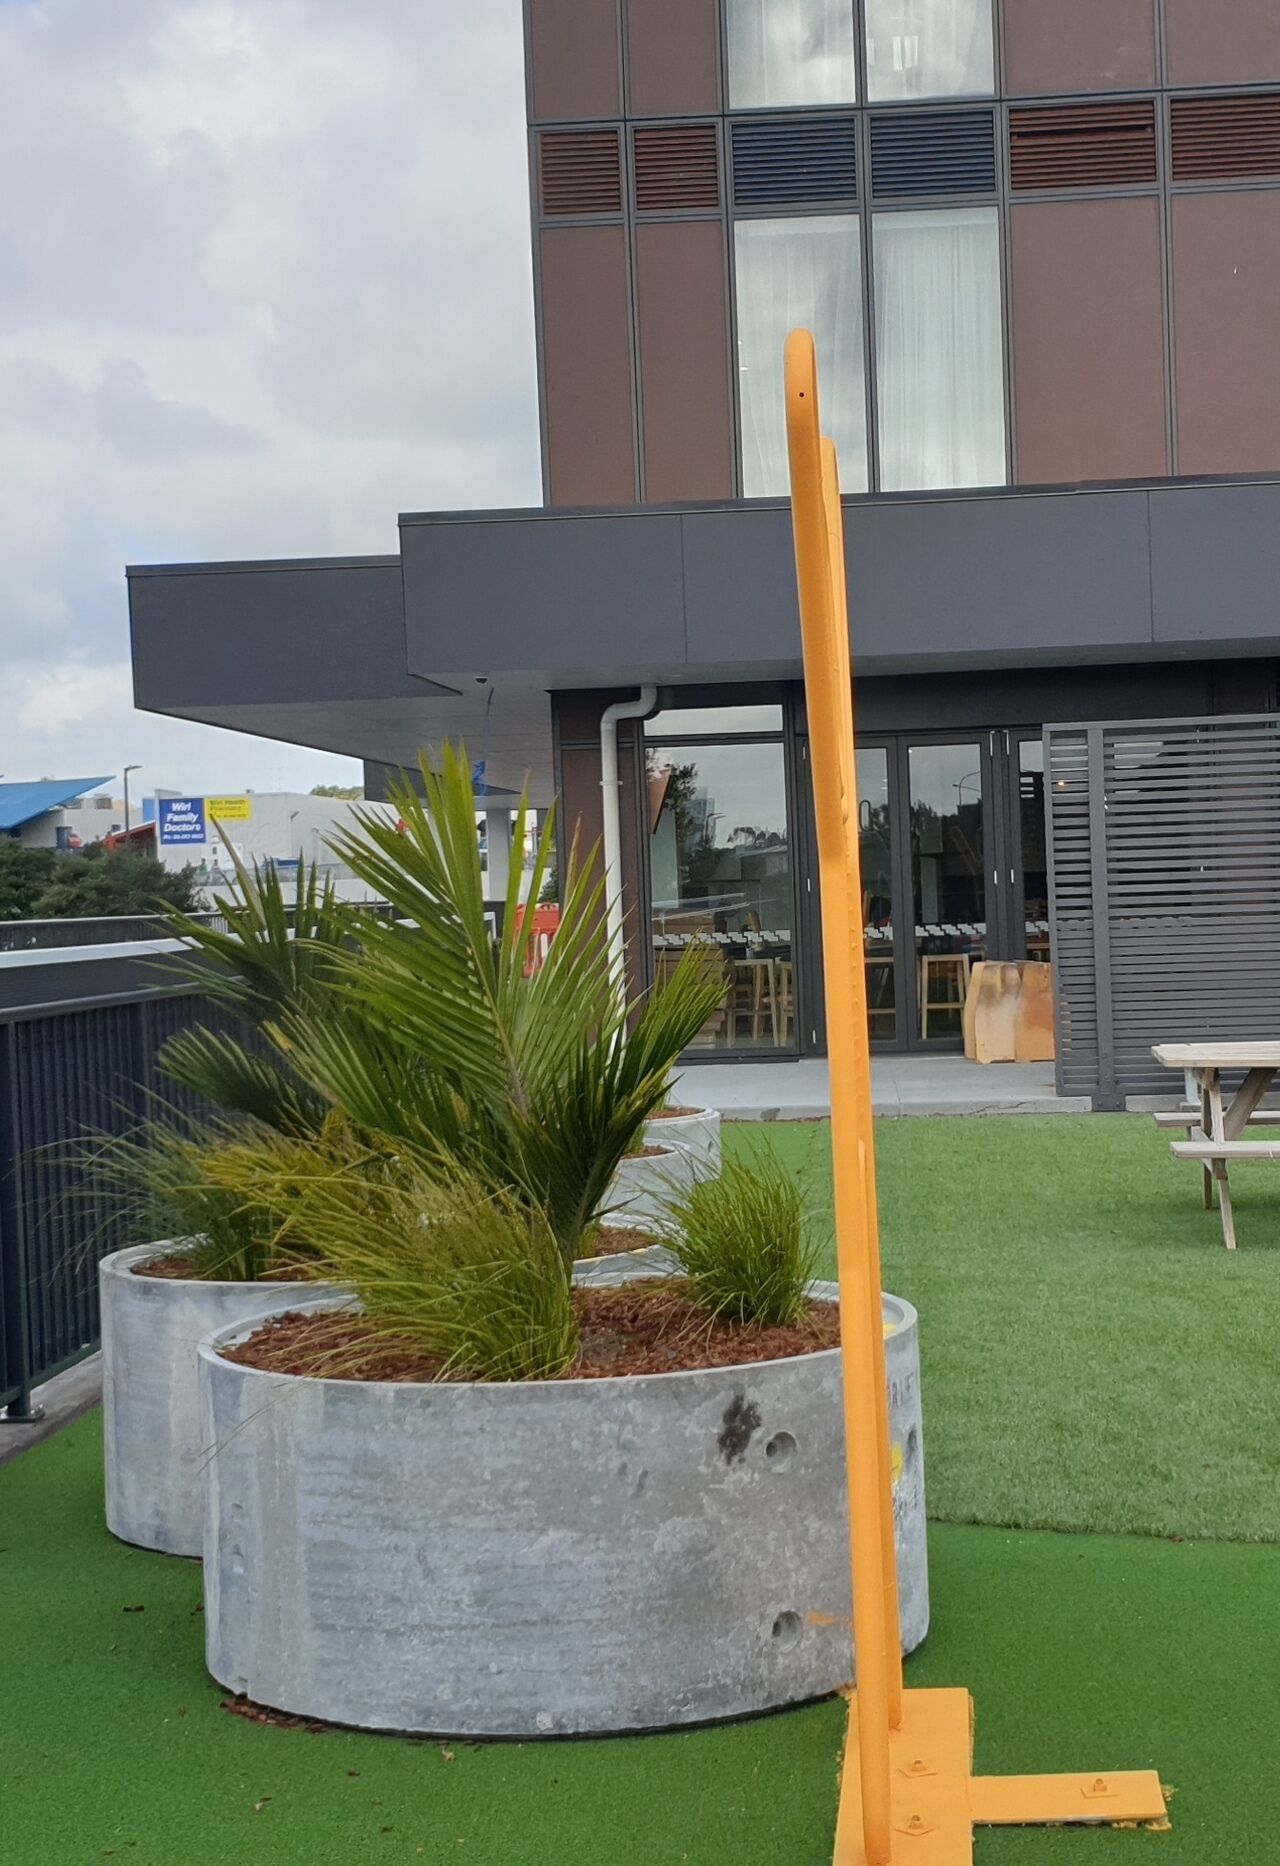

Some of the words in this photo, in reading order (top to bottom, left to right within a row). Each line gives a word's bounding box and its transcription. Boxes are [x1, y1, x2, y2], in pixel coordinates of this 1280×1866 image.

[171, 802, 192, 811] Wiri
[166, 813, 199, 823] Family
[163, 823, 202, 832] Doctors
